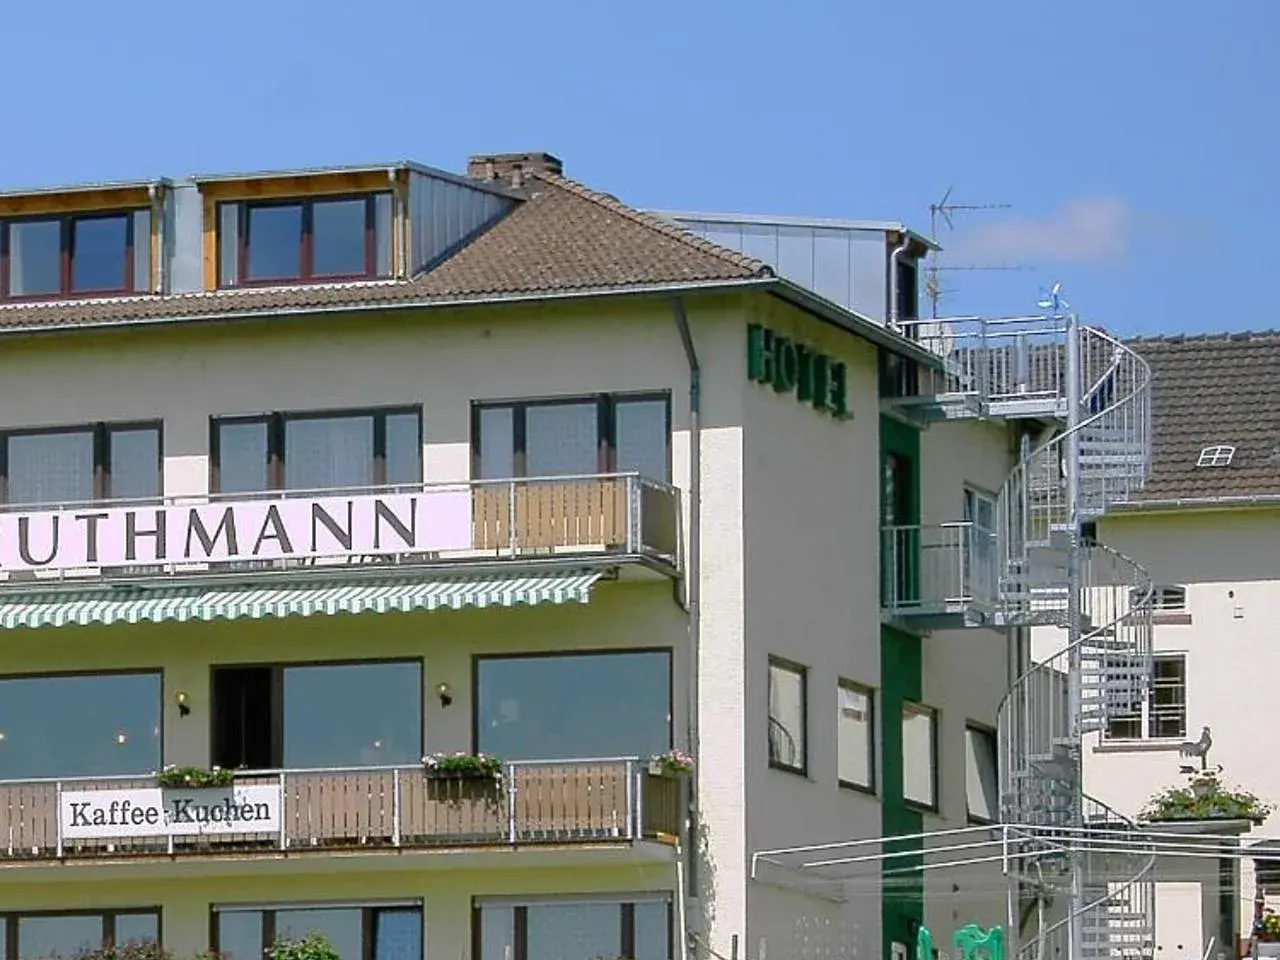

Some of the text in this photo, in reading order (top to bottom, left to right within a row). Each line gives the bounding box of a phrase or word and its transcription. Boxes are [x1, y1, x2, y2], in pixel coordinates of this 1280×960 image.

[747, 323, 853, 419] HOTEL
[69, 800, 159, 827] Kaffee
[172, 797, 271, 824] Kuchen
